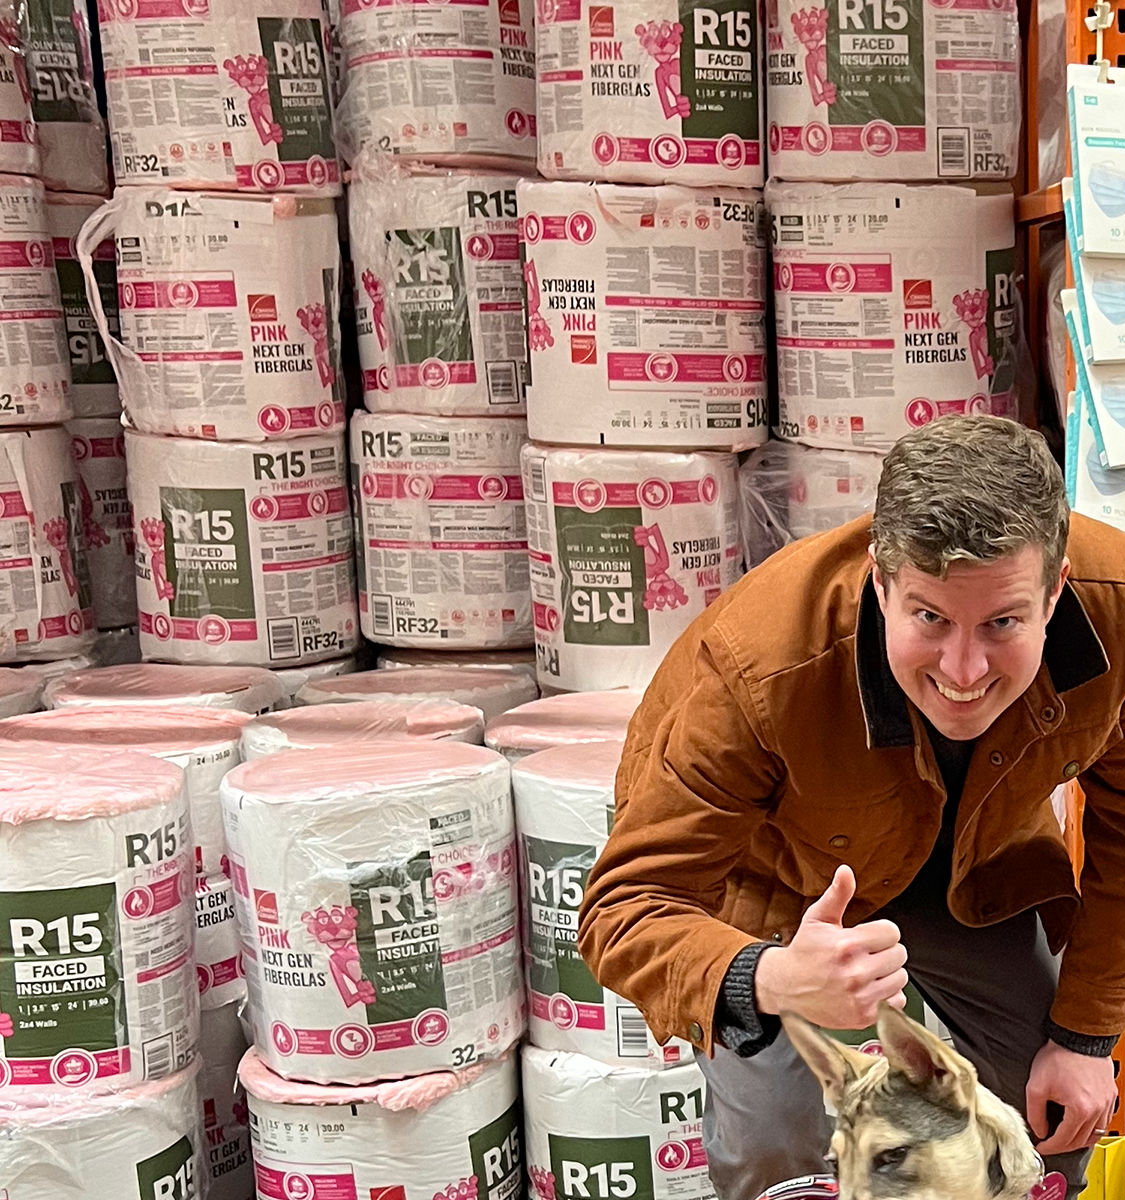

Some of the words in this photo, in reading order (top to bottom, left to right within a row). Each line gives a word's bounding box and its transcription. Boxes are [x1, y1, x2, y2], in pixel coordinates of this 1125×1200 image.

[838, 0, 909, 30] R15
[500, 28, 528, 46] PINK
[694, 9, 751, 47] R15
[590, 42, 623, 60] PINK
[852, 38, 895, 51] FACED
[273, 41, 320, 75] R15
[708, 53, 744, 67] FACED
[839, 53, 910, 66] INSULATION
[590, 64, 615, 78] NEXT
[618, 64, 642, 78] GEN
[694, 69, 752, 82] INSULATION
[591, 82, 652, 97] FIBERGLAS
[467, 190, 518, 218] R15
[722, 203, 754, 222] RF32
[1110, 228, 1120, 237] 10
[541, 279, 595, 293] FIBERGLAS
[547, 296, 567, 310] GEN
[568, 296, 596, 310] NEXT
[562, 314, 596, 331] PINK
[903, 312, 941, 330] PINK
[251, 325, 288, 341] PINK
[904, 333, 933, 347] NEXT
[936, 332, 959, 346] GEN
[252, 345, 283, 357] NEXT
[284, 344, 306, 357] GEN
[905, 347, 967, 364] FIBERGLAS
[254, 359, 314, 373] FIBERGLAS
[361, 431, 403, 458] R15
[253, 450, 306, 480] R15
[1102, 505, 1112, 515] 10
[172, 510, 234, 541] R15
[673, 536, 720, 555] FIBERGLAS
[569, 560, 631, 571] INSULATION
[682, 555, 702, 570] GEN
[582, 574, 619, 585] FACED
[572, 590, 635, 623] R15
[396, 618, 439, 634] RF32
[303, 632, 338, 652] RF32
[125, 826, 177, 867] R15
[530, 862, 584, 906] R15
[207, 892, 229, 910] GEN
[538, 909, 573, 926] FACED
[9, 912, 103, 957] R15
[257, 925, 291, 949] PINK
[391, 923, 439, 943] FACED
[261, 950, 284, 968] NEXT
[287, 951, 314, 969] GEN
[32, 962, 88, 978] FACED
[264, 967, 327, 988] FIBERGLAS
[16, 976, 107, 996] INSULATION
[35, 1017, 57, 1028] Walls
[660, 1088, 703, 1124] R1
[321, 1123, 345, 1133] 30.00
[222, 1138, 242, 1157] GEN
[483, 1125, 520, 1186] R15
[562, 1160, 638, 1198] R15
